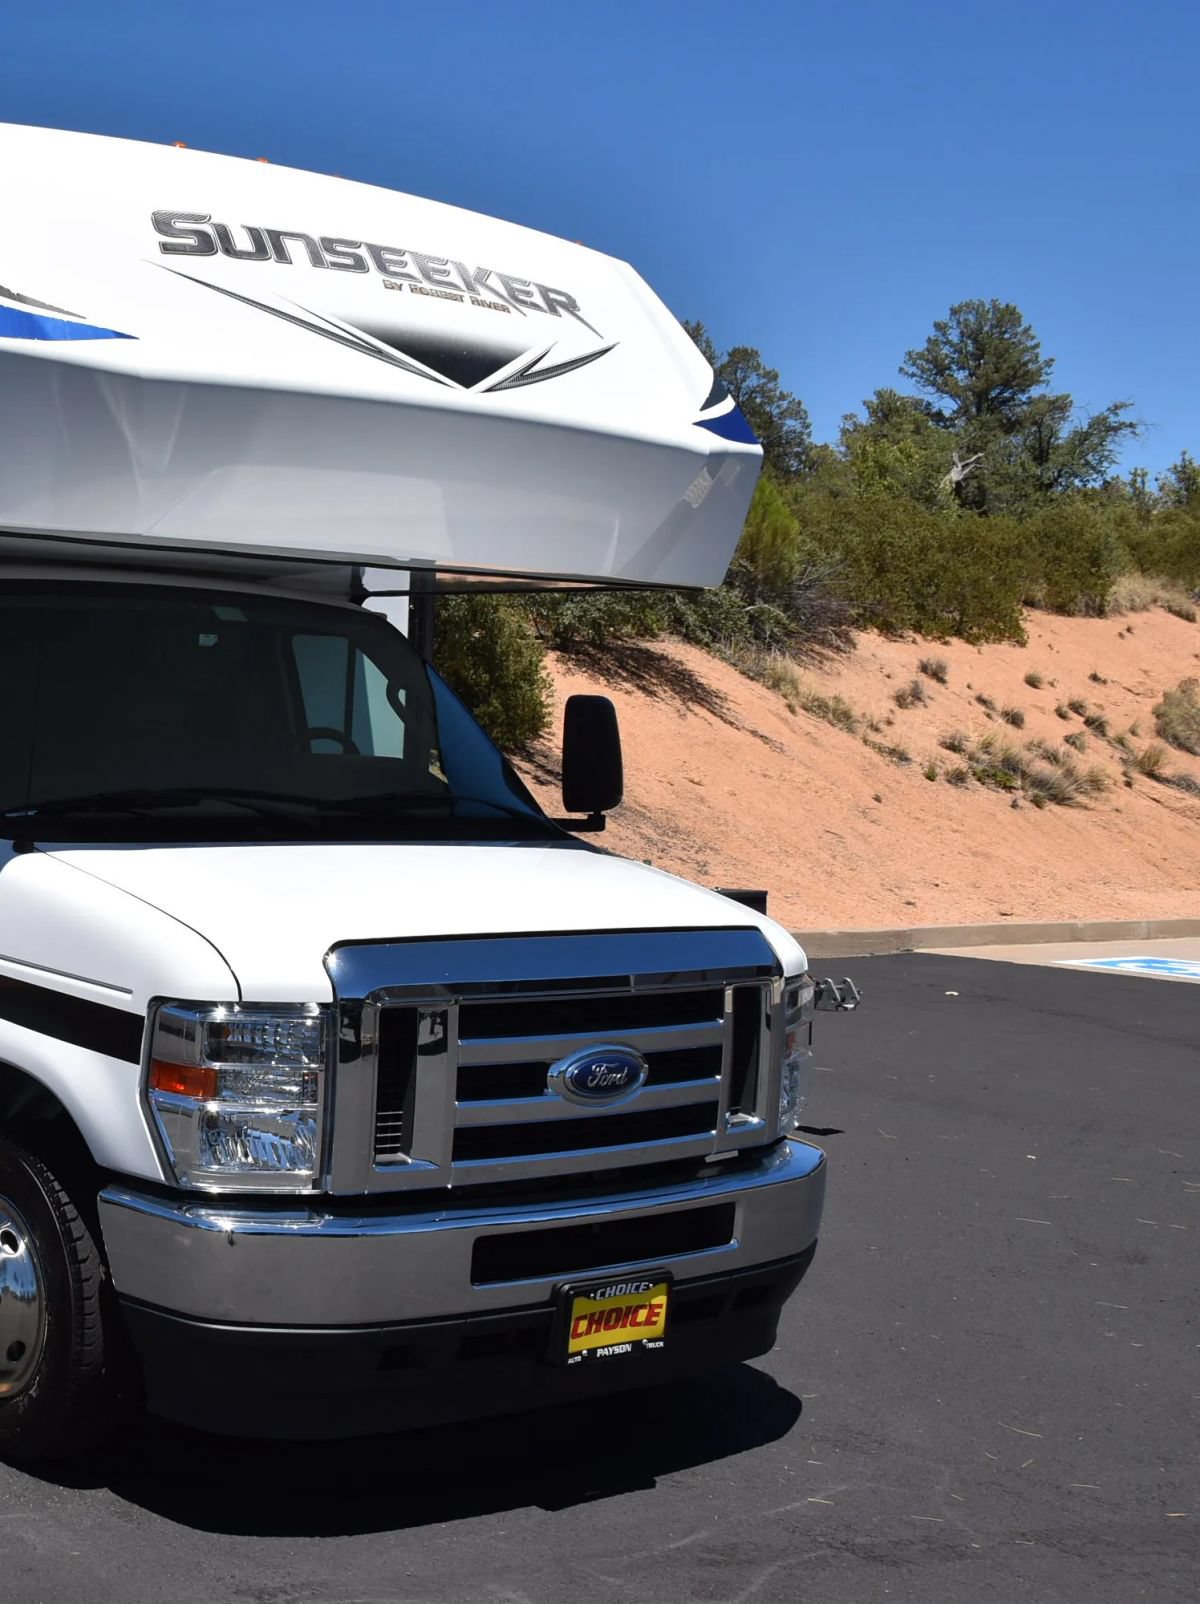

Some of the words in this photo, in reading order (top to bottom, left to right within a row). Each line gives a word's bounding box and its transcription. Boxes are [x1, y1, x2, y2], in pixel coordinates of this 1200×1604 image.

[382, 279, 403, 292] BY
[408, 283, 465, 303] FOREST
[469, 295, 511, 314] RIVER
[587, 1062, 628, 1088] Ford
[595, 1282, 648, 1300] CHOICE
[570, 1303, 663, 1340] CHOICE
[596, 1343, 632, 1358] PAYSON
[646, 1341, 664, 1349] TRUCK
